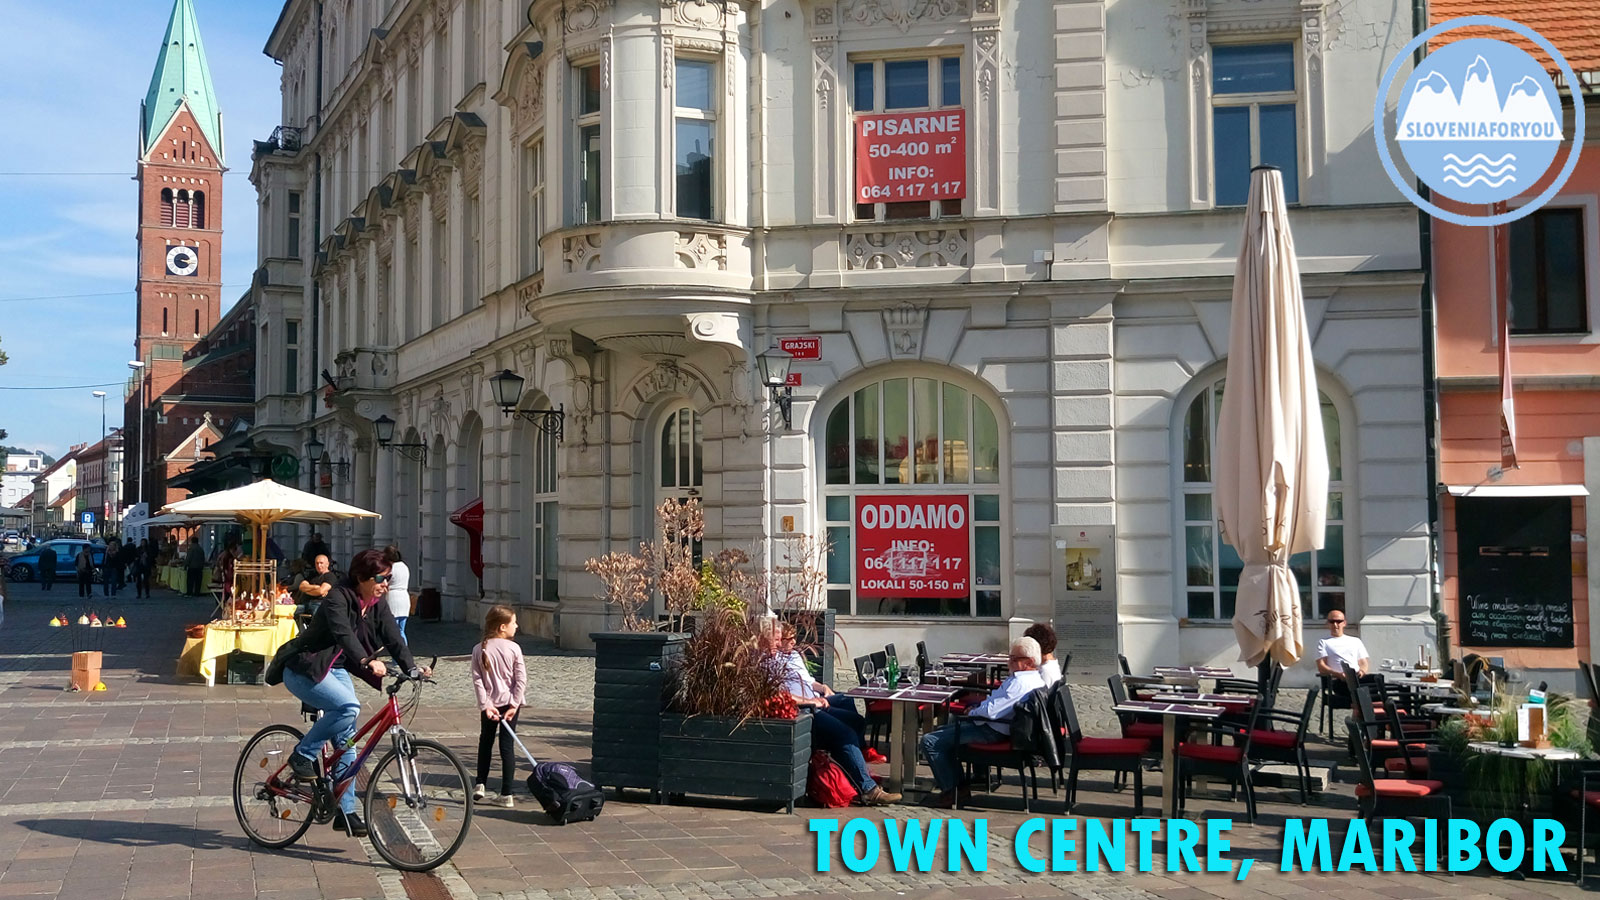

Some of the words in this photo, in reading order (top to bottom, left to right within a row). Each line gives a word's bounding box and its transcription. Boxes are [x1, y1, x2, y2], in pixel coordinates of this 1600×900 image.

[862, 114, 960, 137] PISARNE
[869, 141, 929, 158] 50-400
[935, 136, 957, 154] m²
[888, 165, 934, 180] INFO:
[861, 184, 891, 198] 064
[896, 183, 925, 197] 117
[931, 181, 961, 195] 117
[861, 503, 965, 529] ODDAMO
[891, 540, 935, 552] INFO:
[864, 557, 893, 570] 064
[898, 557, 926, 570] 117
[932, 557, 962, 570] 117
[861, 579, 905, 589] LOKALI
[909, 580, 949, 590] 50-150
[1525, 622, 1543, 631] and
